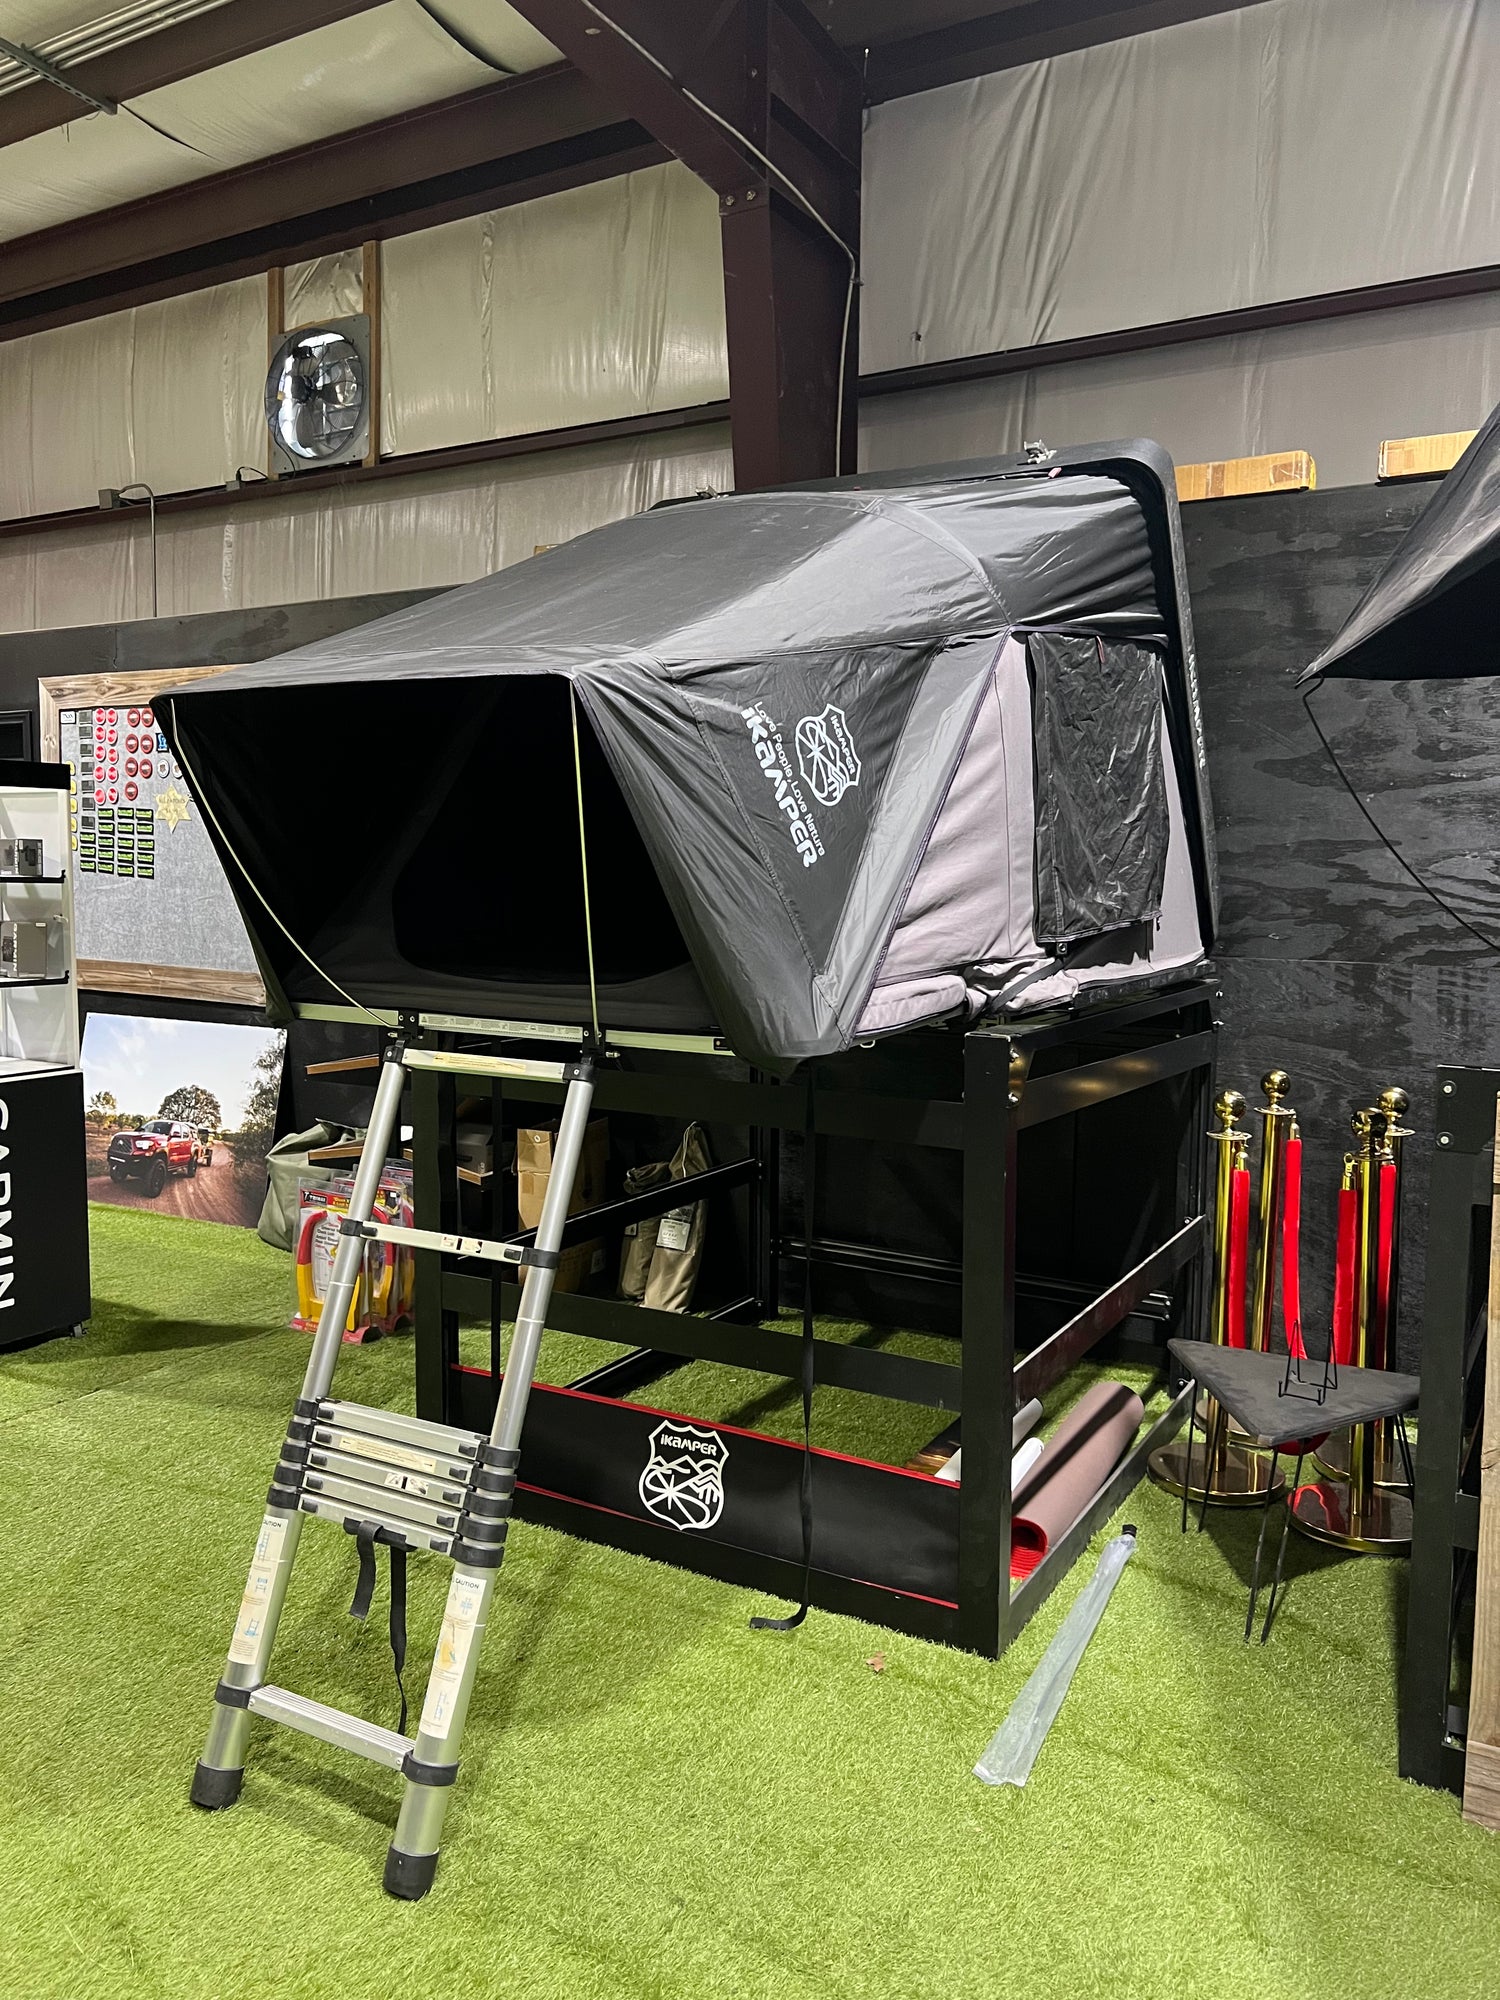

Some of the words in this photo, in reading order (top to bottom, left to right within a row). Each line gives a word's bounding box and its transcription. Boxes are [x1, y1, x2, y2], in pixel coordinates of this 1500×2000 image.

[753, 701, 777, 732] Love
[772, 733, 793, 783] People,
[790, 780, 808, 813] Love
[804, 813, 826, 856] Nature
[455, 1577, 480, 1589] CAUTION
